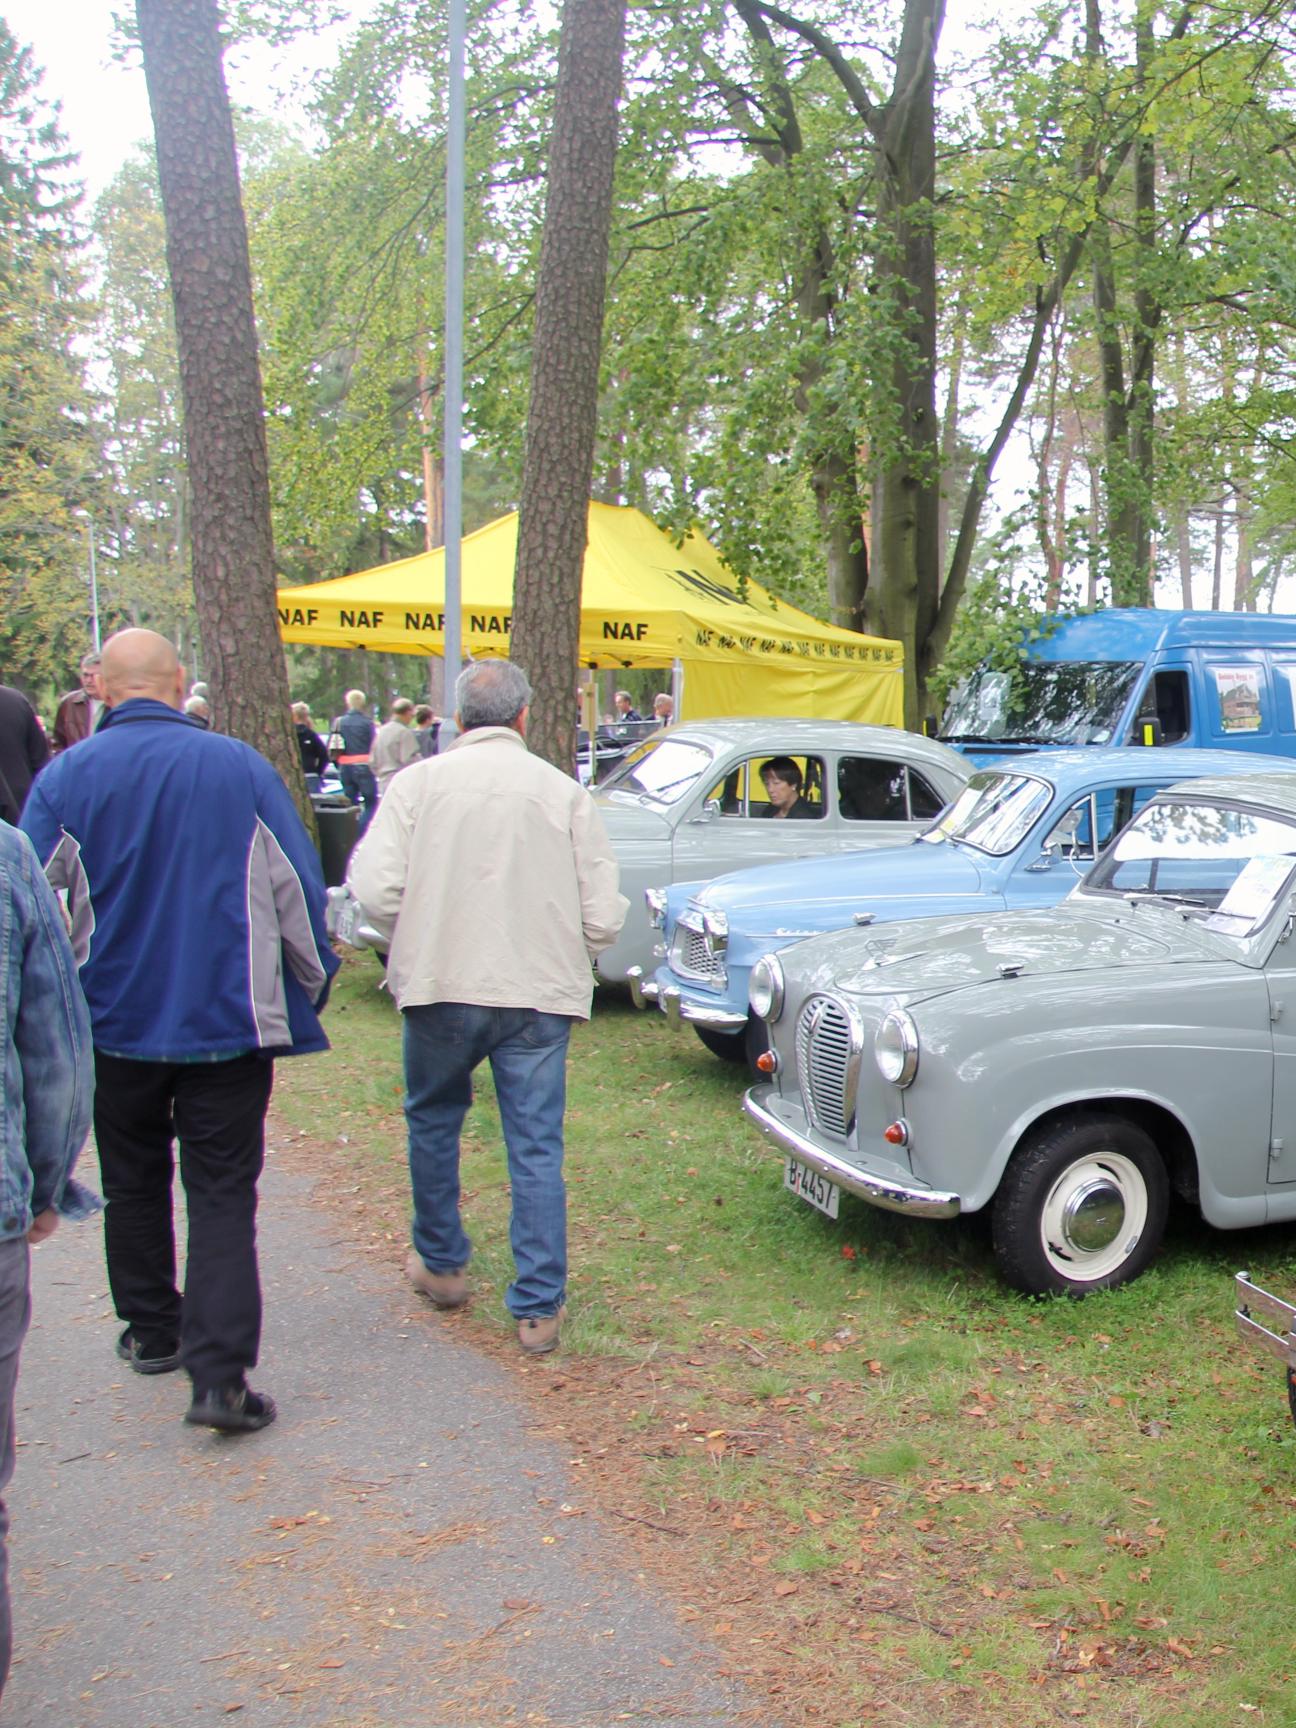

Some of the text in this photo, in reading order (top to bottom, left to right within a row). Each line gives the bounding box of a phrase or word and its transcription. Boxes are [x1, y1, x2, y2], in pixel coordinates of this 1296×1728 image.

[278, 608, 648, 641] NAF NAF NAF NAF NAF
[697, 629, 714, 646] NAF
